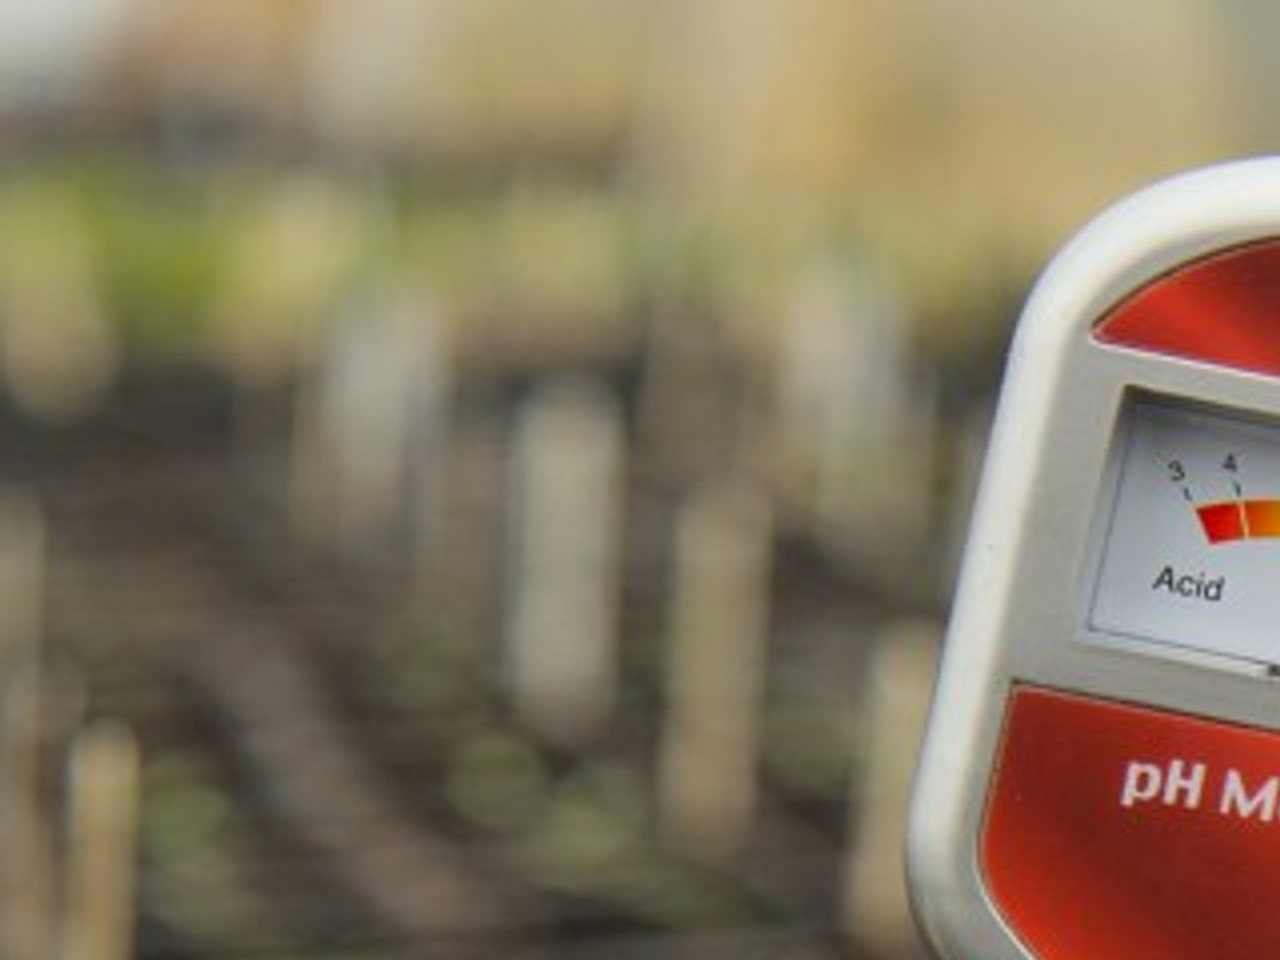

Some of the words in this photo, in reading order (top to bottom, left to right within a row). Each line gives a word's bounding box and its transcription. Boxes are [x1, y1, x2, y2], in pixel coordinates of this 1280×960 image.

[1167, 459, 1188, 483] 3
[1222, 453, 1239, 473] 4
[1151, 564, 1226, 603] Acid
[1120, 758, 1207, 810] pH
